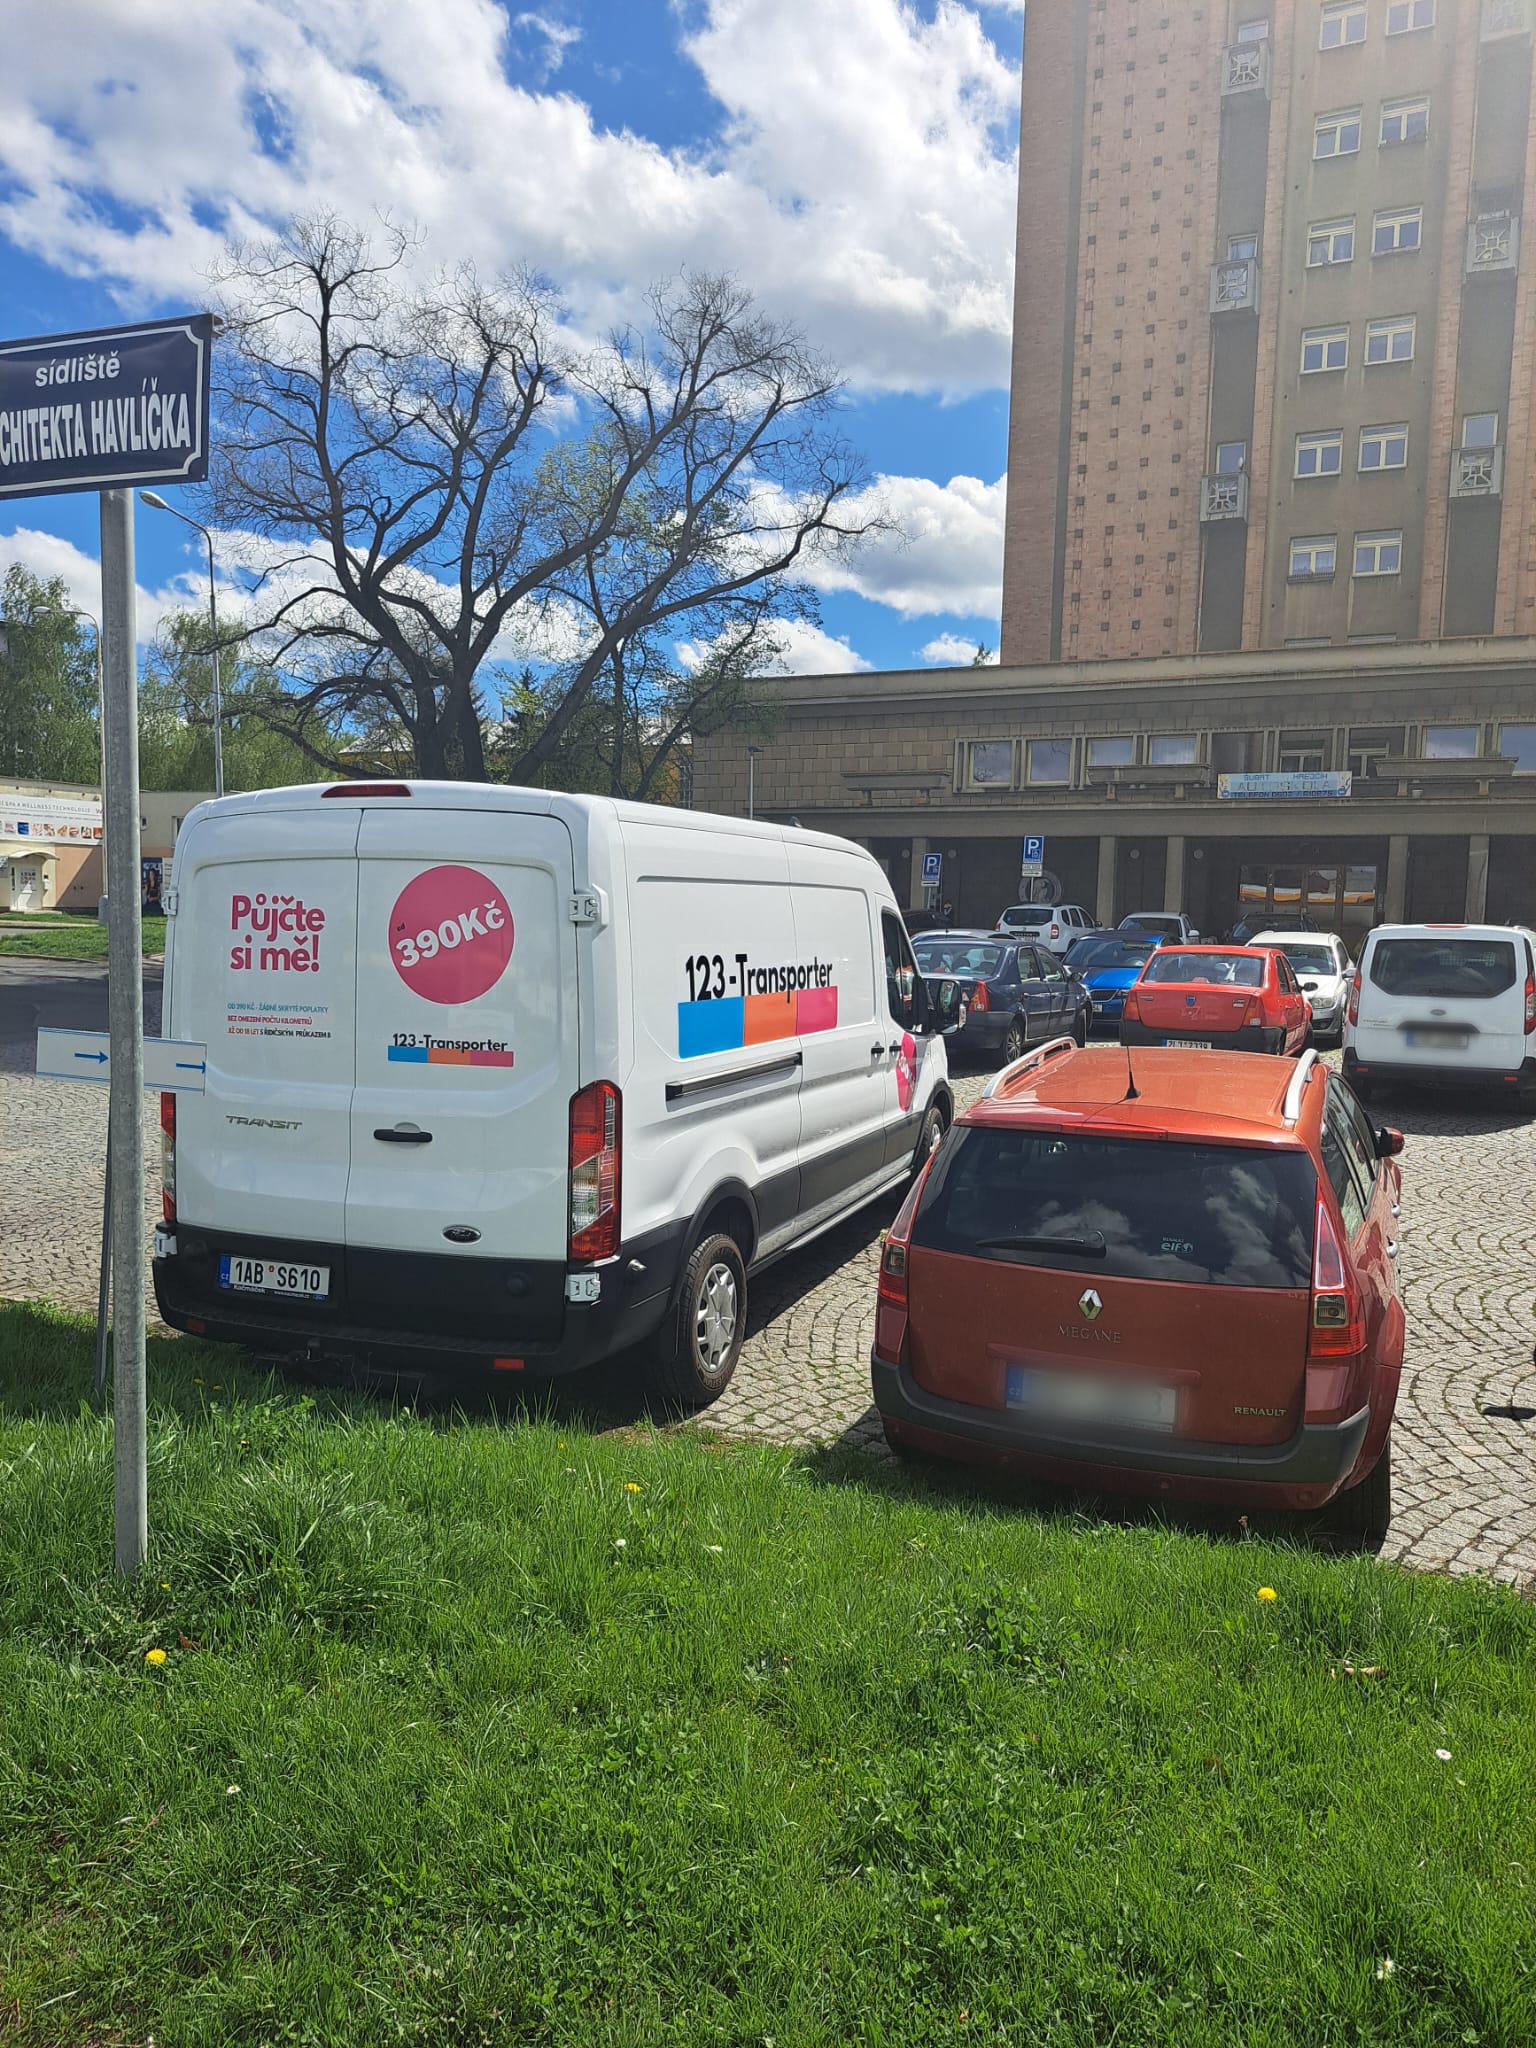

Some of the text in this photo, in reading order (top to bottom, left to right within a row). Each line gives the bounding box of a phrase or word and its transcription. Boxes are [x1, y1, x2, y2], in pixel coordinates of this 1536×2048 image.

[35, 350, 120, 387] sídliště
[91, 376, 191, 455] HAVLÍČKA
[1028, 839, 1040, 855] P
[927, 857, 938, 873] P
[231, 893, 326, 942] Půjčte
[396, 900, 505, 967] 390Kč
[230, 934, 320, 972] si mě!
[225, 1115, 303, 1130] TRANSIT
[235, 1260, 321, 1291] 1AB S610
[1232, 1406, 1287, 1417] RENAULT
